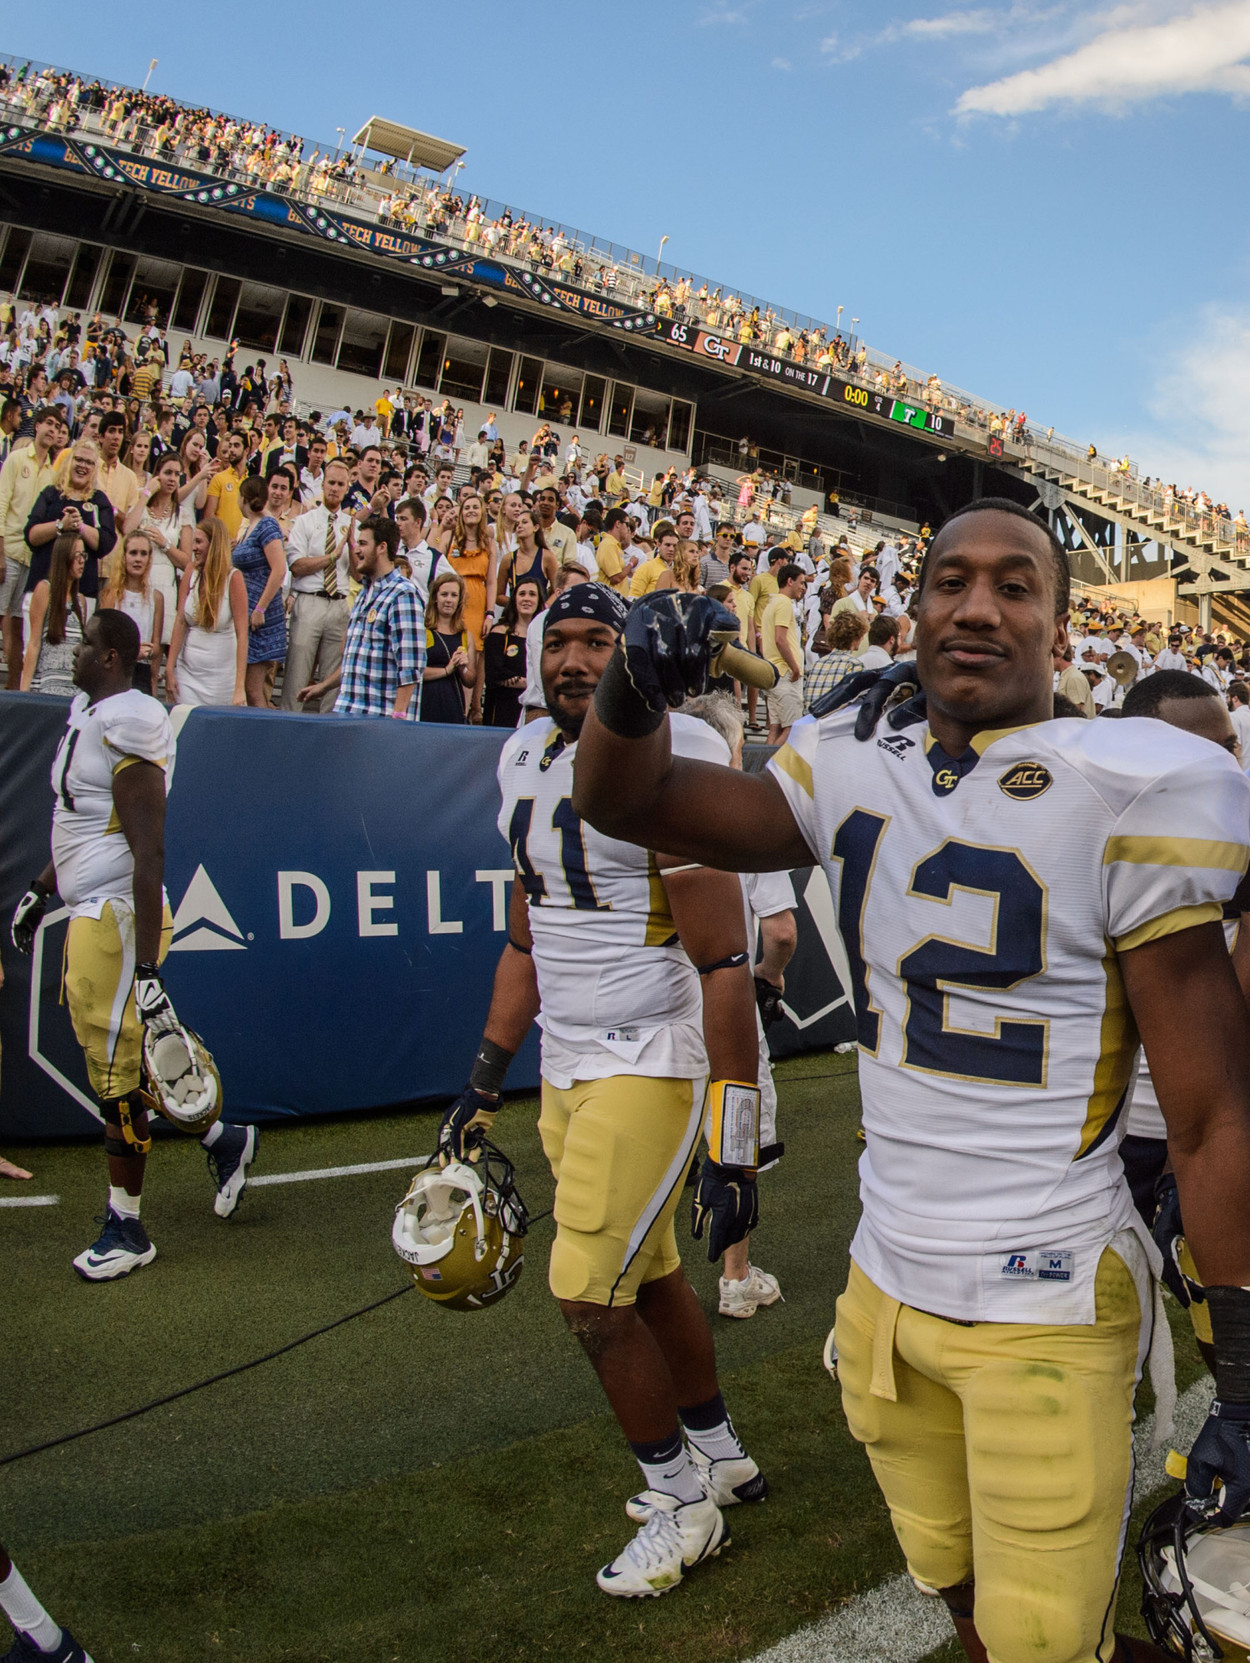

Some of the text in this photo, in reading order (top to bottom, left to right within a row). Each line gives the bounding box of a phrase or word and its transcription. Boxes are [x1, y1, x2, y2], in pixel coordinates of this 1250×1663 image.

[671, 323, 688, 342] 65
[770, 359, 782, 374] 10
[807, 372, 818, 387] 17
[844, 384, 869, 407] 0:00
[930, 414, 942, 431] 10
[990, 437, 1002, 457] 25
[936, 770, 958, 789] GT
[1006, 770, 1047, 786] ACC
[508, 795, 613, 912] 41
[277, 869, 516, 940] DELT
[830, 806, 1051, 1090] 12
[1049, 1259, 1062, 1269] M
